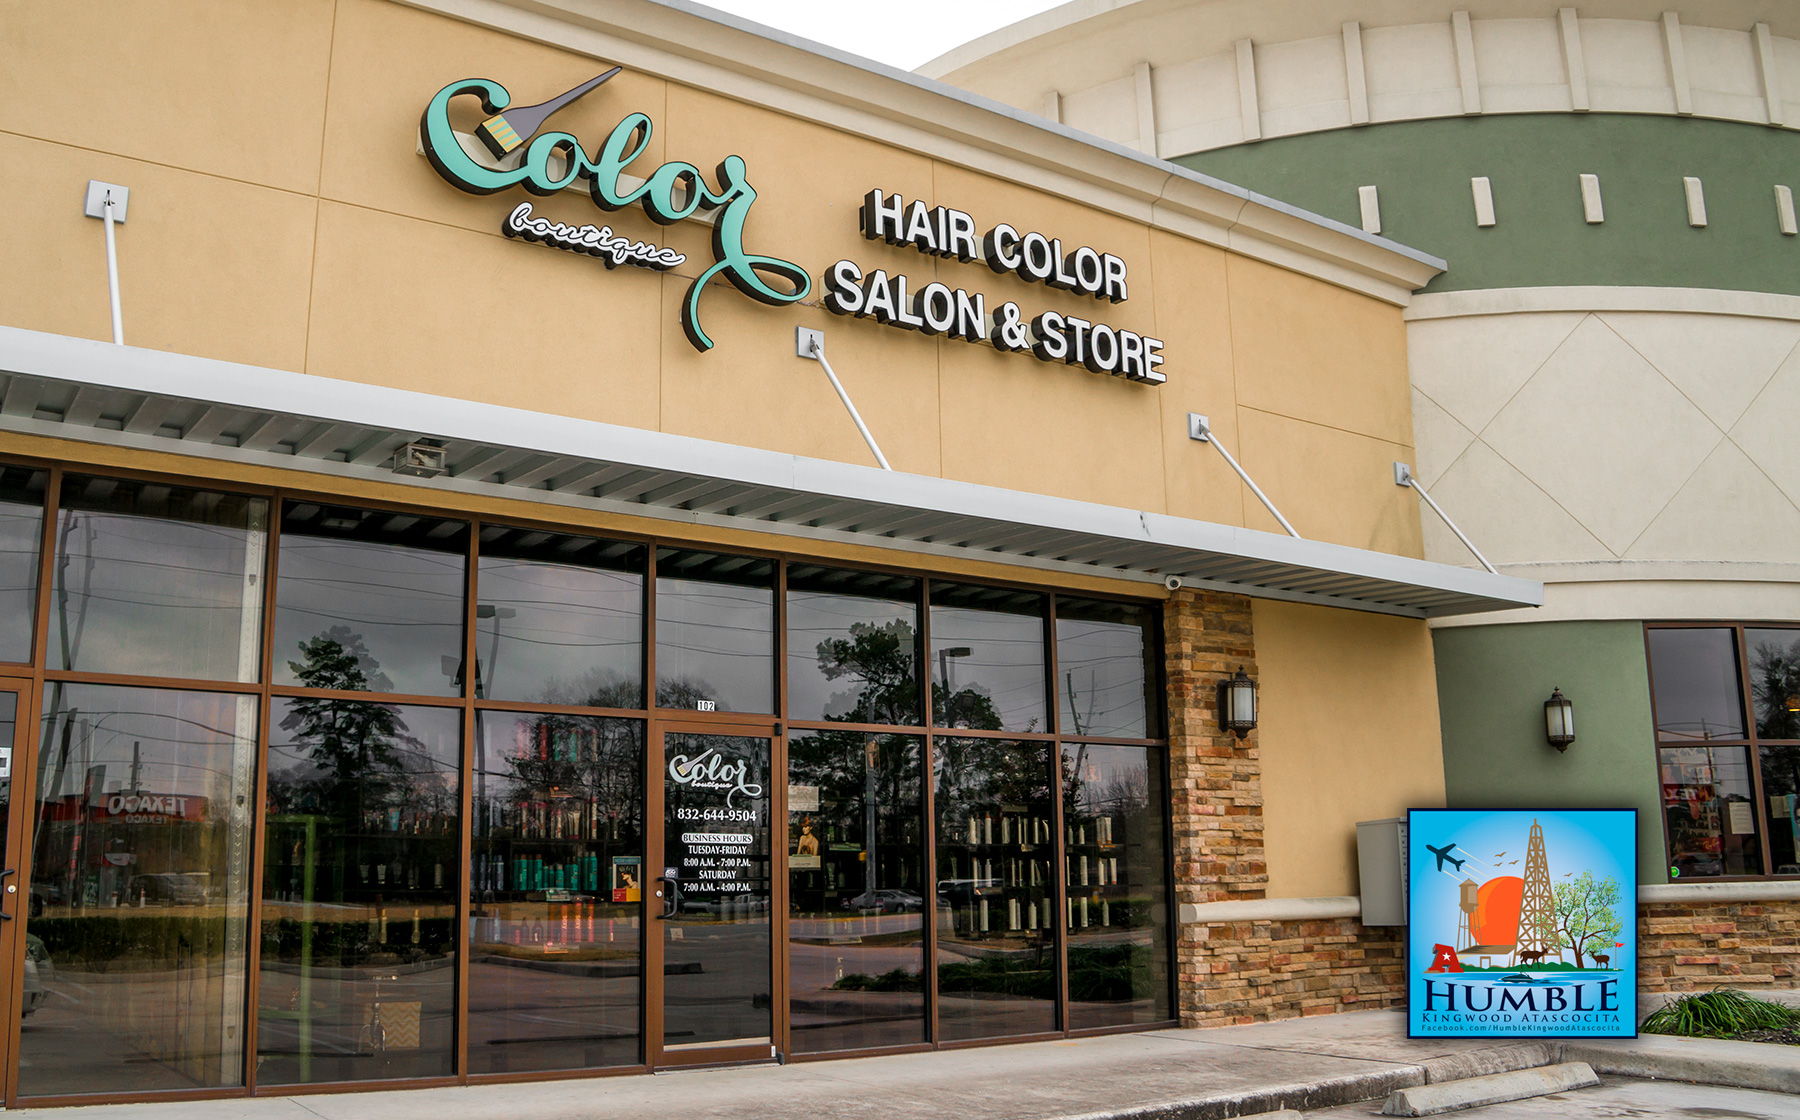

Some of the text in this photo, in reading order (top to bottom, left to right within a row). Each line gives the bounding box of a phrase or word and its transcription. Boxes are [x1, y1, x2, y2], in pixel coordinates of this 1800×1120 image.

[421, 78, 812, 352] Color
[505, 201, 687, 269] boutique
[867, 188, 1128, 302] HAIR COLOR
[826, 259, 1167, 385] SALON & STORE
[699, 701, 714, 711] 102
[669, 754, 762, 808] Color
[691, 781, 733, 790] boutique
[677, 808, 757, 821] 832-644-9504
[683, 834, 752, 843] BUSINESS HOURS
[688, 845, 747, 855] TUESDAY-FRIDAY
[684, 858, 699, 867] 8:00
[700, 858, 715, 867] A.M.
[721, 858, 735, 867] 7:00
[736, 859, 751, 867] P.M.
[699, 870, 737, 879] SATURDAY
[684, 883, 699, 892] 7:00
[700, 883, 715, 892] A.M.
[721, 883, 735, 892] 4:00
[736, 883, 751, 892] P.M.
